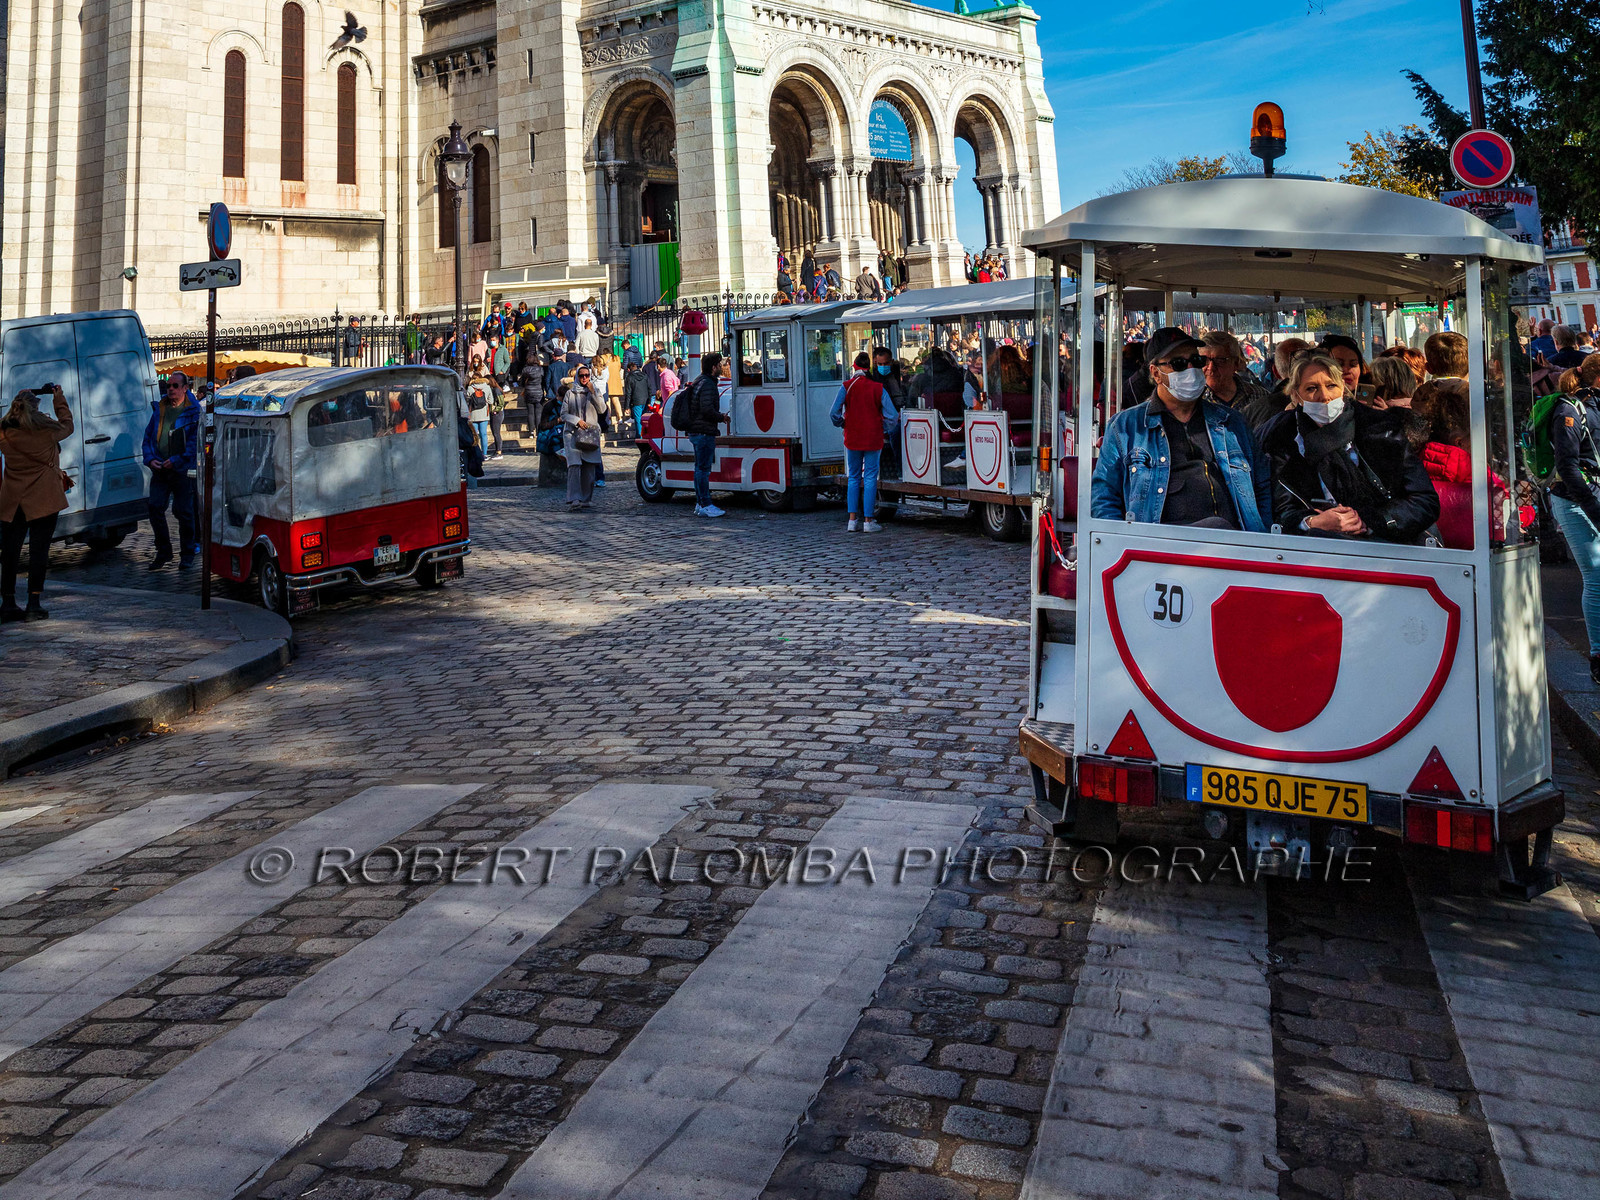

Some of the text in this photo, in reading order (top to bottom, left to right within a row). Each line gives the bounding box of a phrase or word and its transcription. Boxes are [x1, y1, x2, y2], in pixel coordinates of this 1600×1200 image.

[1153, 582, 1184, 623] 30
[1191, 771, 1360, 818] F 985 QJE 75
